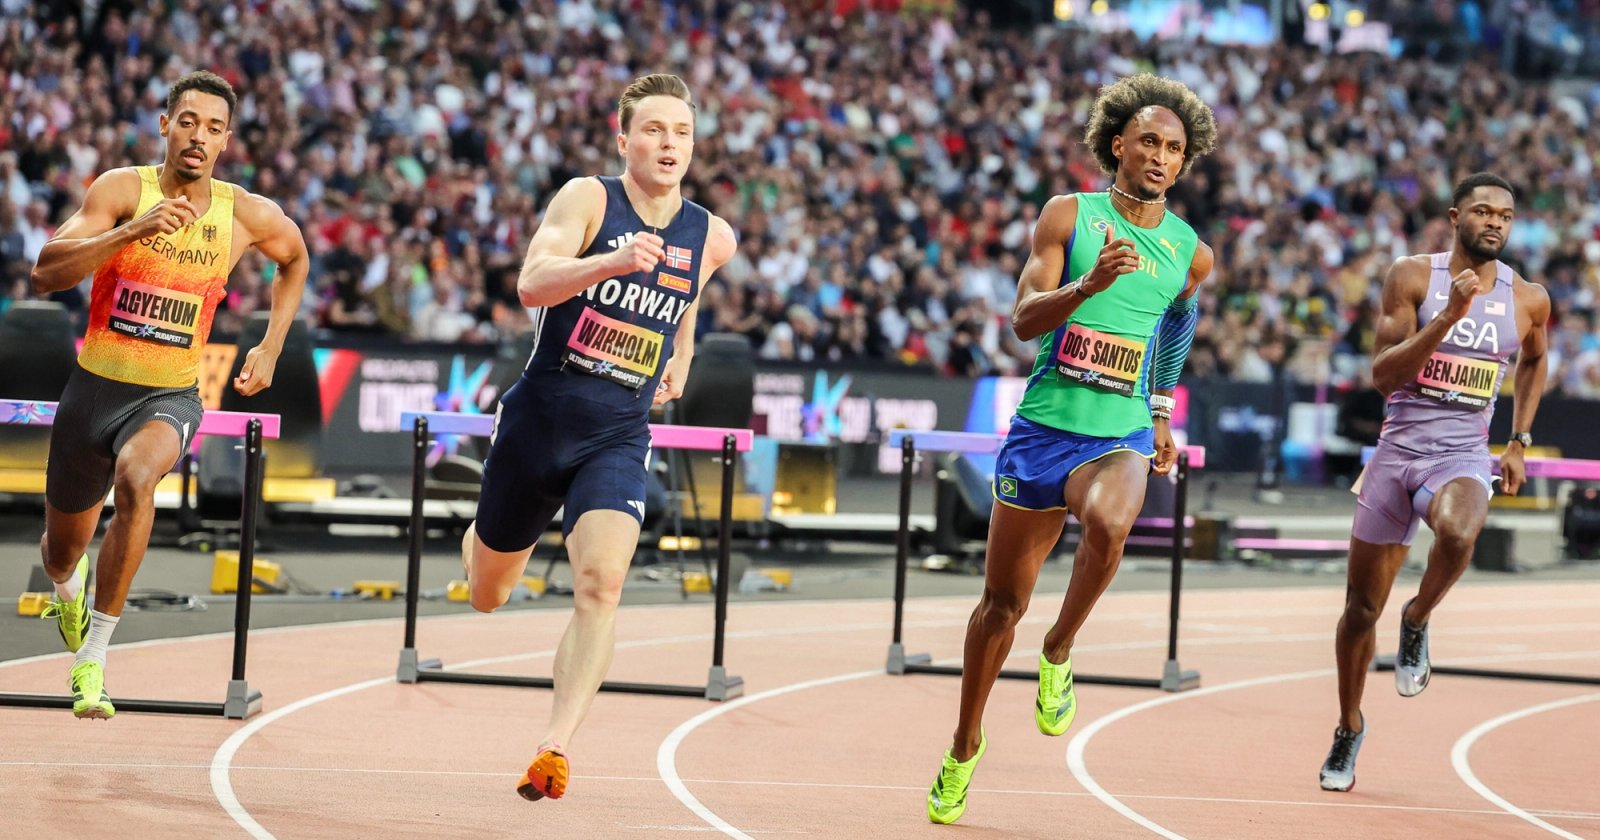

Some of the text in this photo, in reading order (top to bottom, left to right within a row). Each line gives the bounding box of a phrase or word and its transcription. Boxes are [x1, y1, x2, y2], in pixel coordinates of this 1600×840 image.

[139, 235, 219, 266] GERMANY
[1138, 255, 1159, 278] SIL
[116, 287, 198, 327] AGYEKUM
[114, 321, 138, 334] ULTIMATE
[154, 331, 182, 344] BUDAPEST
[577, 317, 659, 368] WARHOLM
[568, 352, 640, 384] ULTIMATE BUDAPEST
[1062, 331, 1142, 374] DOS SANTOS
[1059, 365, 1082, 379] ULTIMATE
[1099, 377, 1125, 390] BUDAPEST
[1423, 358, 1494, 391] BENJAMIN
